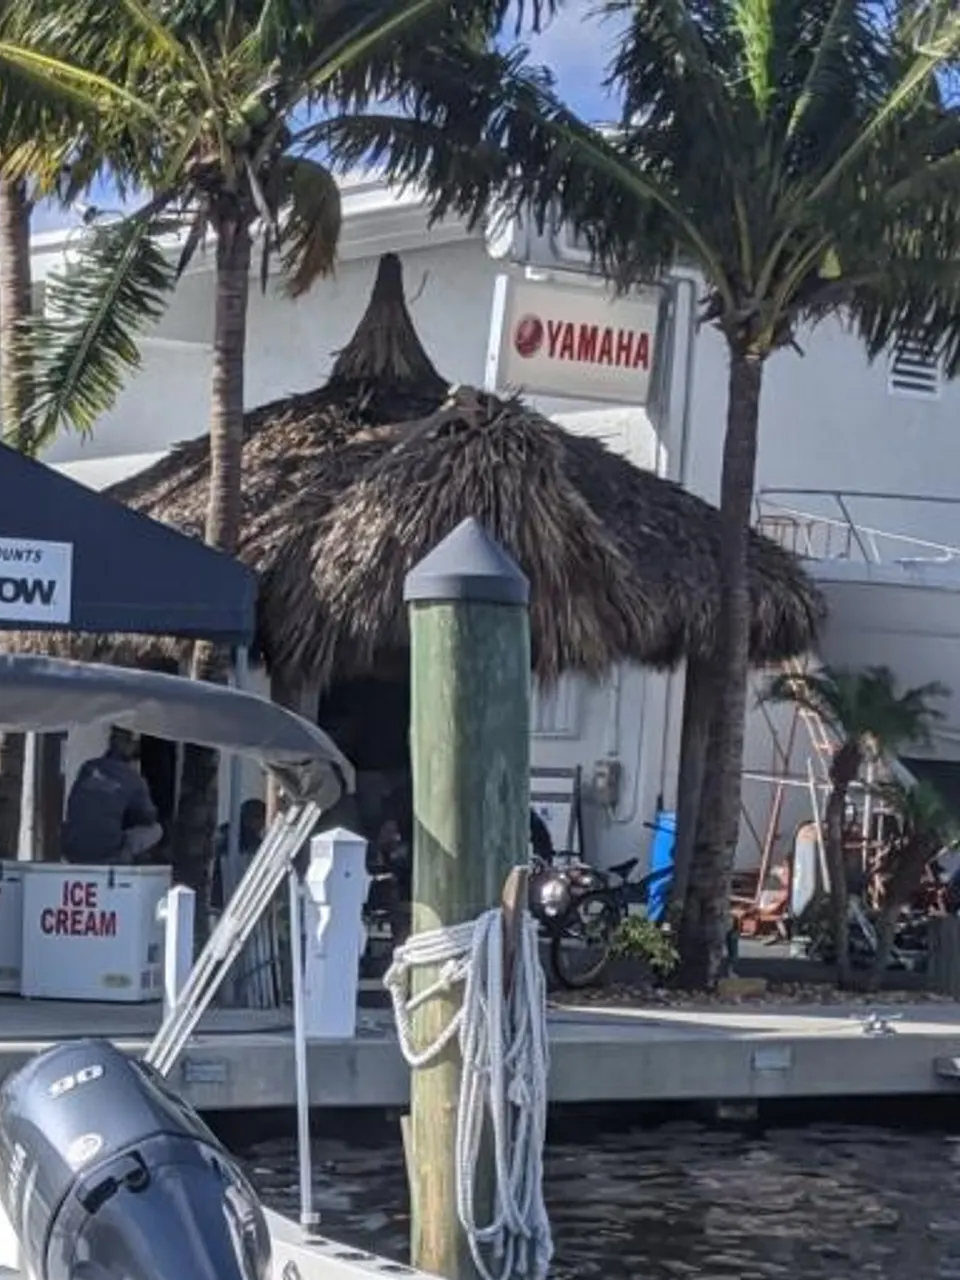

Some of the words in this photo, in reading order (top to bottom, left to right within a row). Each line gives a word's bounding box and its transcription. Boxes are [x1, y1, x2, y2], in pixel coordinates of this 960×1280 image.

[547, 320, 650, 370] YAMAHA
[62, 880, 98, 908] ICE
[40, 910, 117, 937] CREAM
